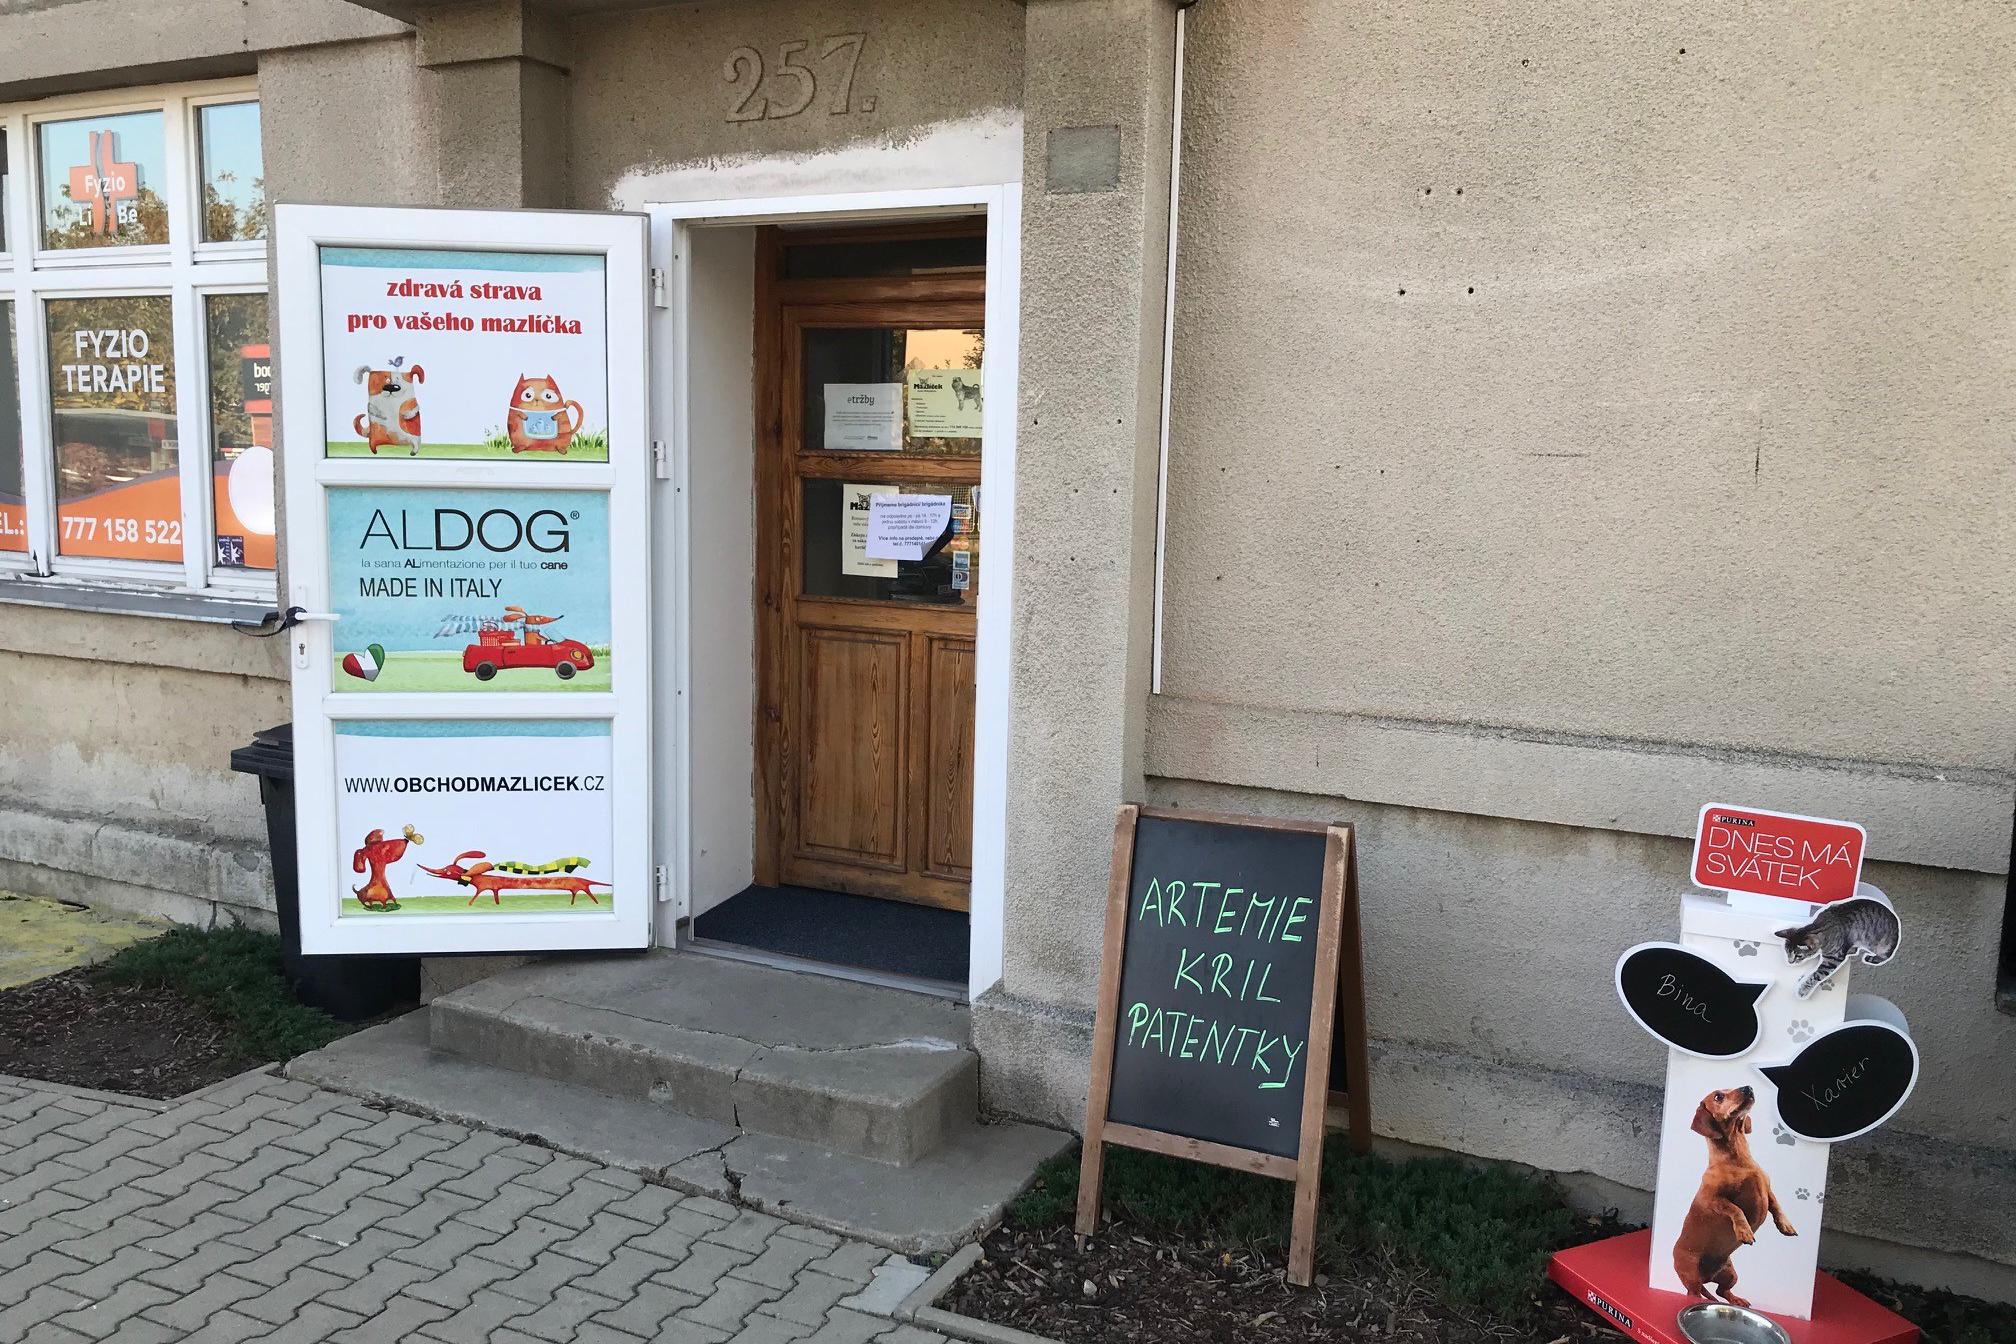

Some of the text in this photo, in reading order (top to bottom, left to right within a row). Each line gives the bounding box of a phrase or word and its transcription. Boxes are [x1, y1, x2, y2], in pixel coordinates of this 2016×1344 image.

[723, 32, 878, 123] 257.
[84, 171, 126, 198] Fyzio
[118, 205, 138, 224] Be
[387, 278, 542, 301] zdravá strava
[347, 311, 582, 335] pro vašeho mazlíčka
[75, 329, 149, 359] FYZIO
[62, 364, 166, 393] TERAPIE
[62, 516, 97, 541] 777
[103, 518, 139, 543] 158
[145, 519, 182, 545] 522
[361, 558, 371, 568] la
[374, 560, 401, 568] sana
[489, 560, 507, 570] per
[510, 559, 516, 569] il
[520, 560, 538, 570] tuo
[540, 561, 568, 570] cane
[359, 577, 502, 598] MADE IN ITALY
[345, 775, 604, 793] WWW.OBCHODMAZLICEK.CZ
[1721, 816, 1755, 827] PURINA
[1708, 826, 1853, 869] DNES MÁ
[1706, 852, 1822, 890] SVÁTEK
[1139, 877, 1314, 944] ARTEMIE
[1174, 948, 1281, 1003] KRIL
[1128, 1002, 1304, 1090] PATENTKY
[1597, 1297, 1632, 1328] PURINA
